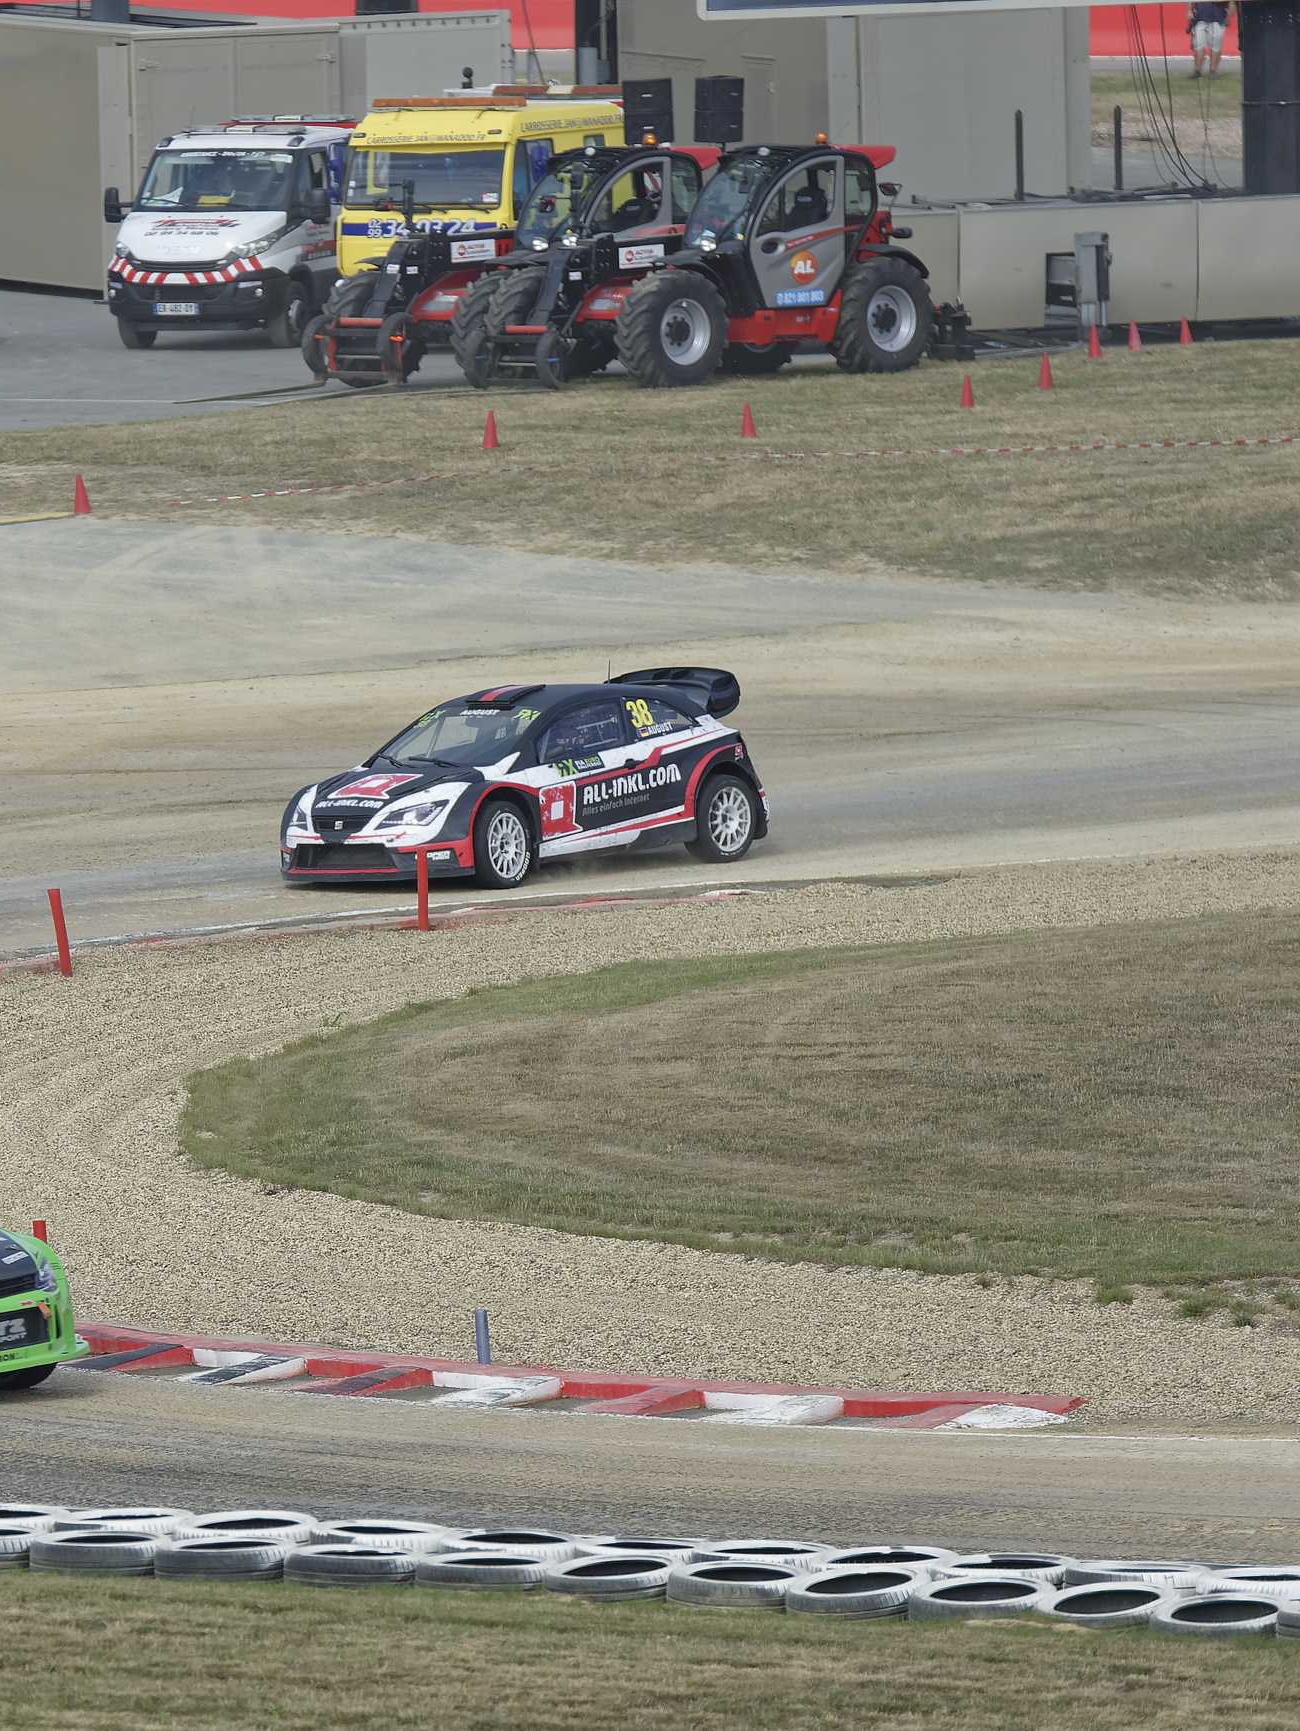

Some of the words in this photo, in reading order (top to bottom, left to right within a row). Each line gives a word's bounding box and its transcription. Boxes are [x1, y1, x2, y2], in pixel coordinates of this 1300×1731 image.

[447, 219, 478, 236] 24
[794, 260, 815, 274] AL
[625, 698, 654, 728] 38
[646, 721, 674, 736] AUGUST
[583, 763, 682, 806] ALL-INKL.COM
[315, 798, 384, 809] ALL-INKL.COM
